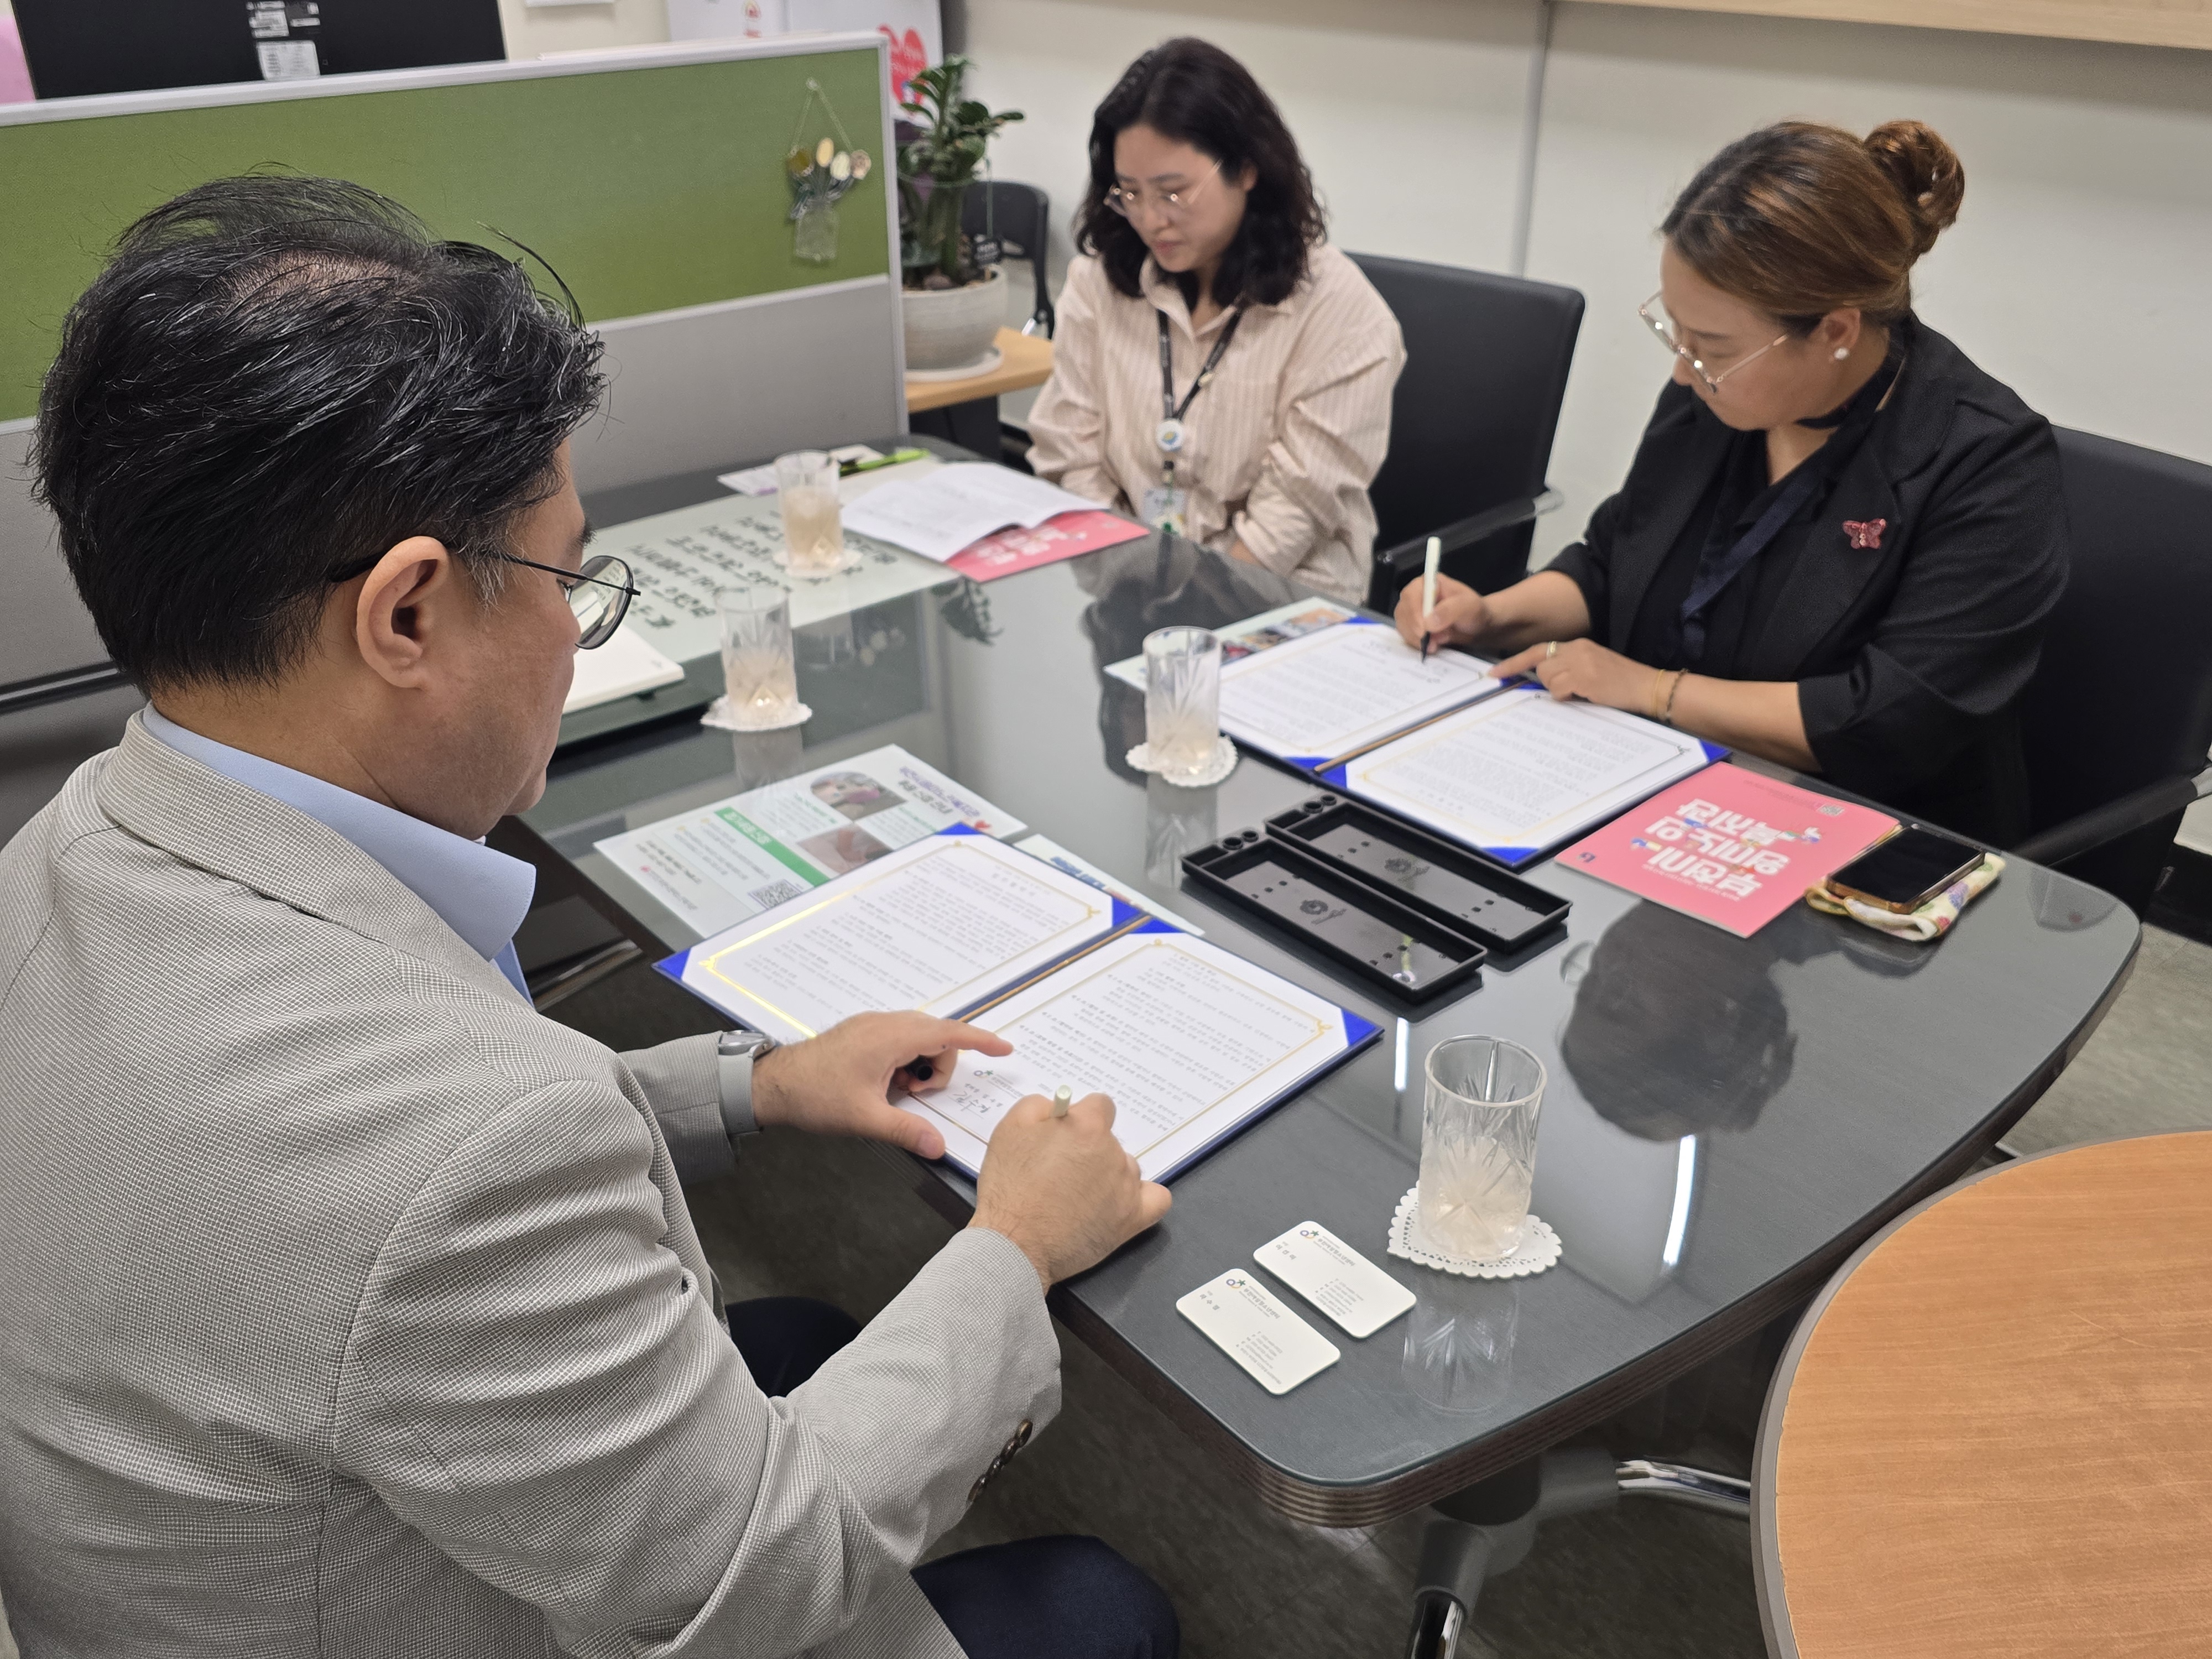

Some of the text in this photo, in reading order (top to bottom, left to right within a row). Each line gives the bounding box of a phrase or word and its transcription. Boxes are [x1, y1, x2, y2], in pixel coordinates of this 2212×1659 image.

[1645, 816, 1790, 874] 원미노인
[1676, 799, 1782, 844] 복지관
[1647, 847, 1762, 898] 부천시
